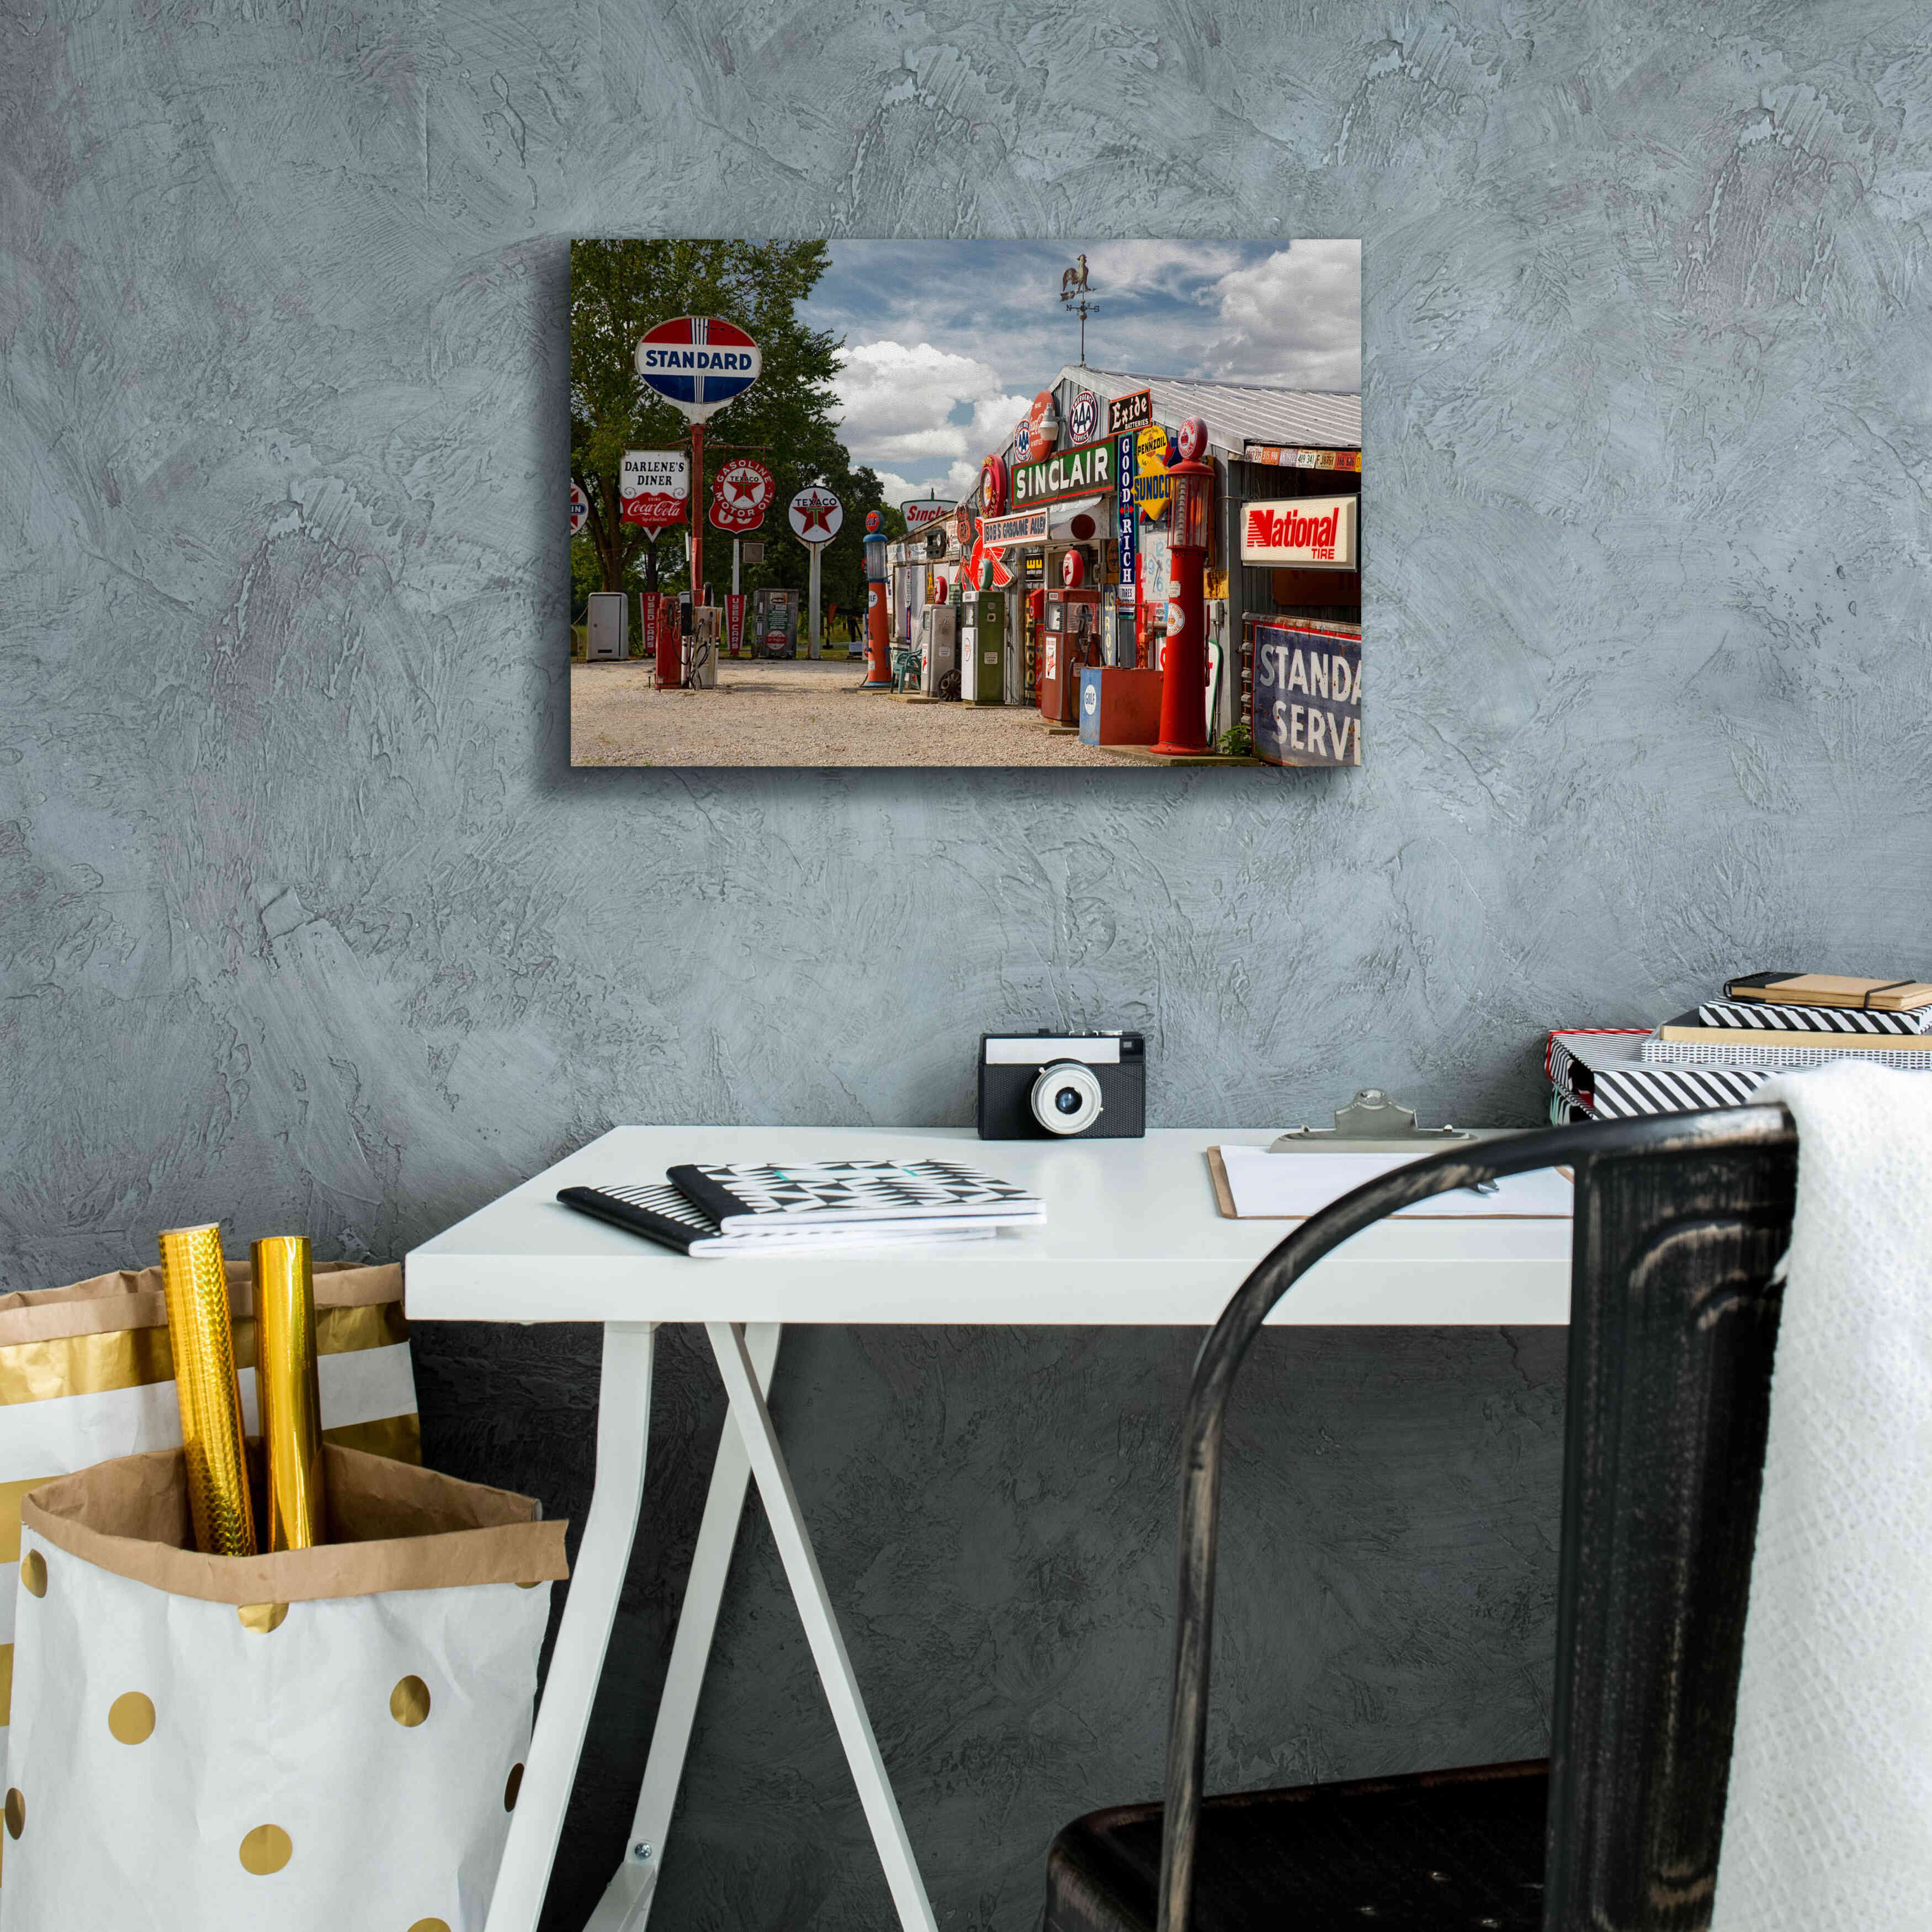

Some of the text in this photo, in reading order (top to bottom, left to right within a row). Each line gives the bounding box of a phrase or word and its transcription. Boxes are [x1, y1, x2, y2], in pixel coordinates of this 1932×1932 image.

[646, 349, 752, 370] STANDARD
[1073, 402, 1091, 433] AAA
[1112, 396, 1148, 431] Exide
[1124, 418, 1149, 429] BATTERIES
[1137, 436, 1166, 456] PENNZOIL
[624, 461, 685, 473] DARLENE'S
[716, 459, 772, 484] GASOLINE
[1016, 447, 1108, 499] SINCLAIR
[637, 475, 672, 486] DINER
[1134, 475, 1170, 502] SUNOCO
[715, 491, 755, 517] MOTOR
[758, 492, 773, 510] OIL
[795, 498, 837, 506] TEXACO
[906, 505, 947, 522] Sincl
[986, 523, 1001, 542] BOB'S
[1002, 518, 1029, 539] GASOLINE
[1030, 516, 1047, 535] ALLEY
[1246, 507, 1339, 548] National
[1312, 548, 1335, 560] TIRE
[1122, 588, 1132, 597] TIRES
[1085, 692, 1096, 706] GULF
[1271, 700, 1361, 766] SERVI
